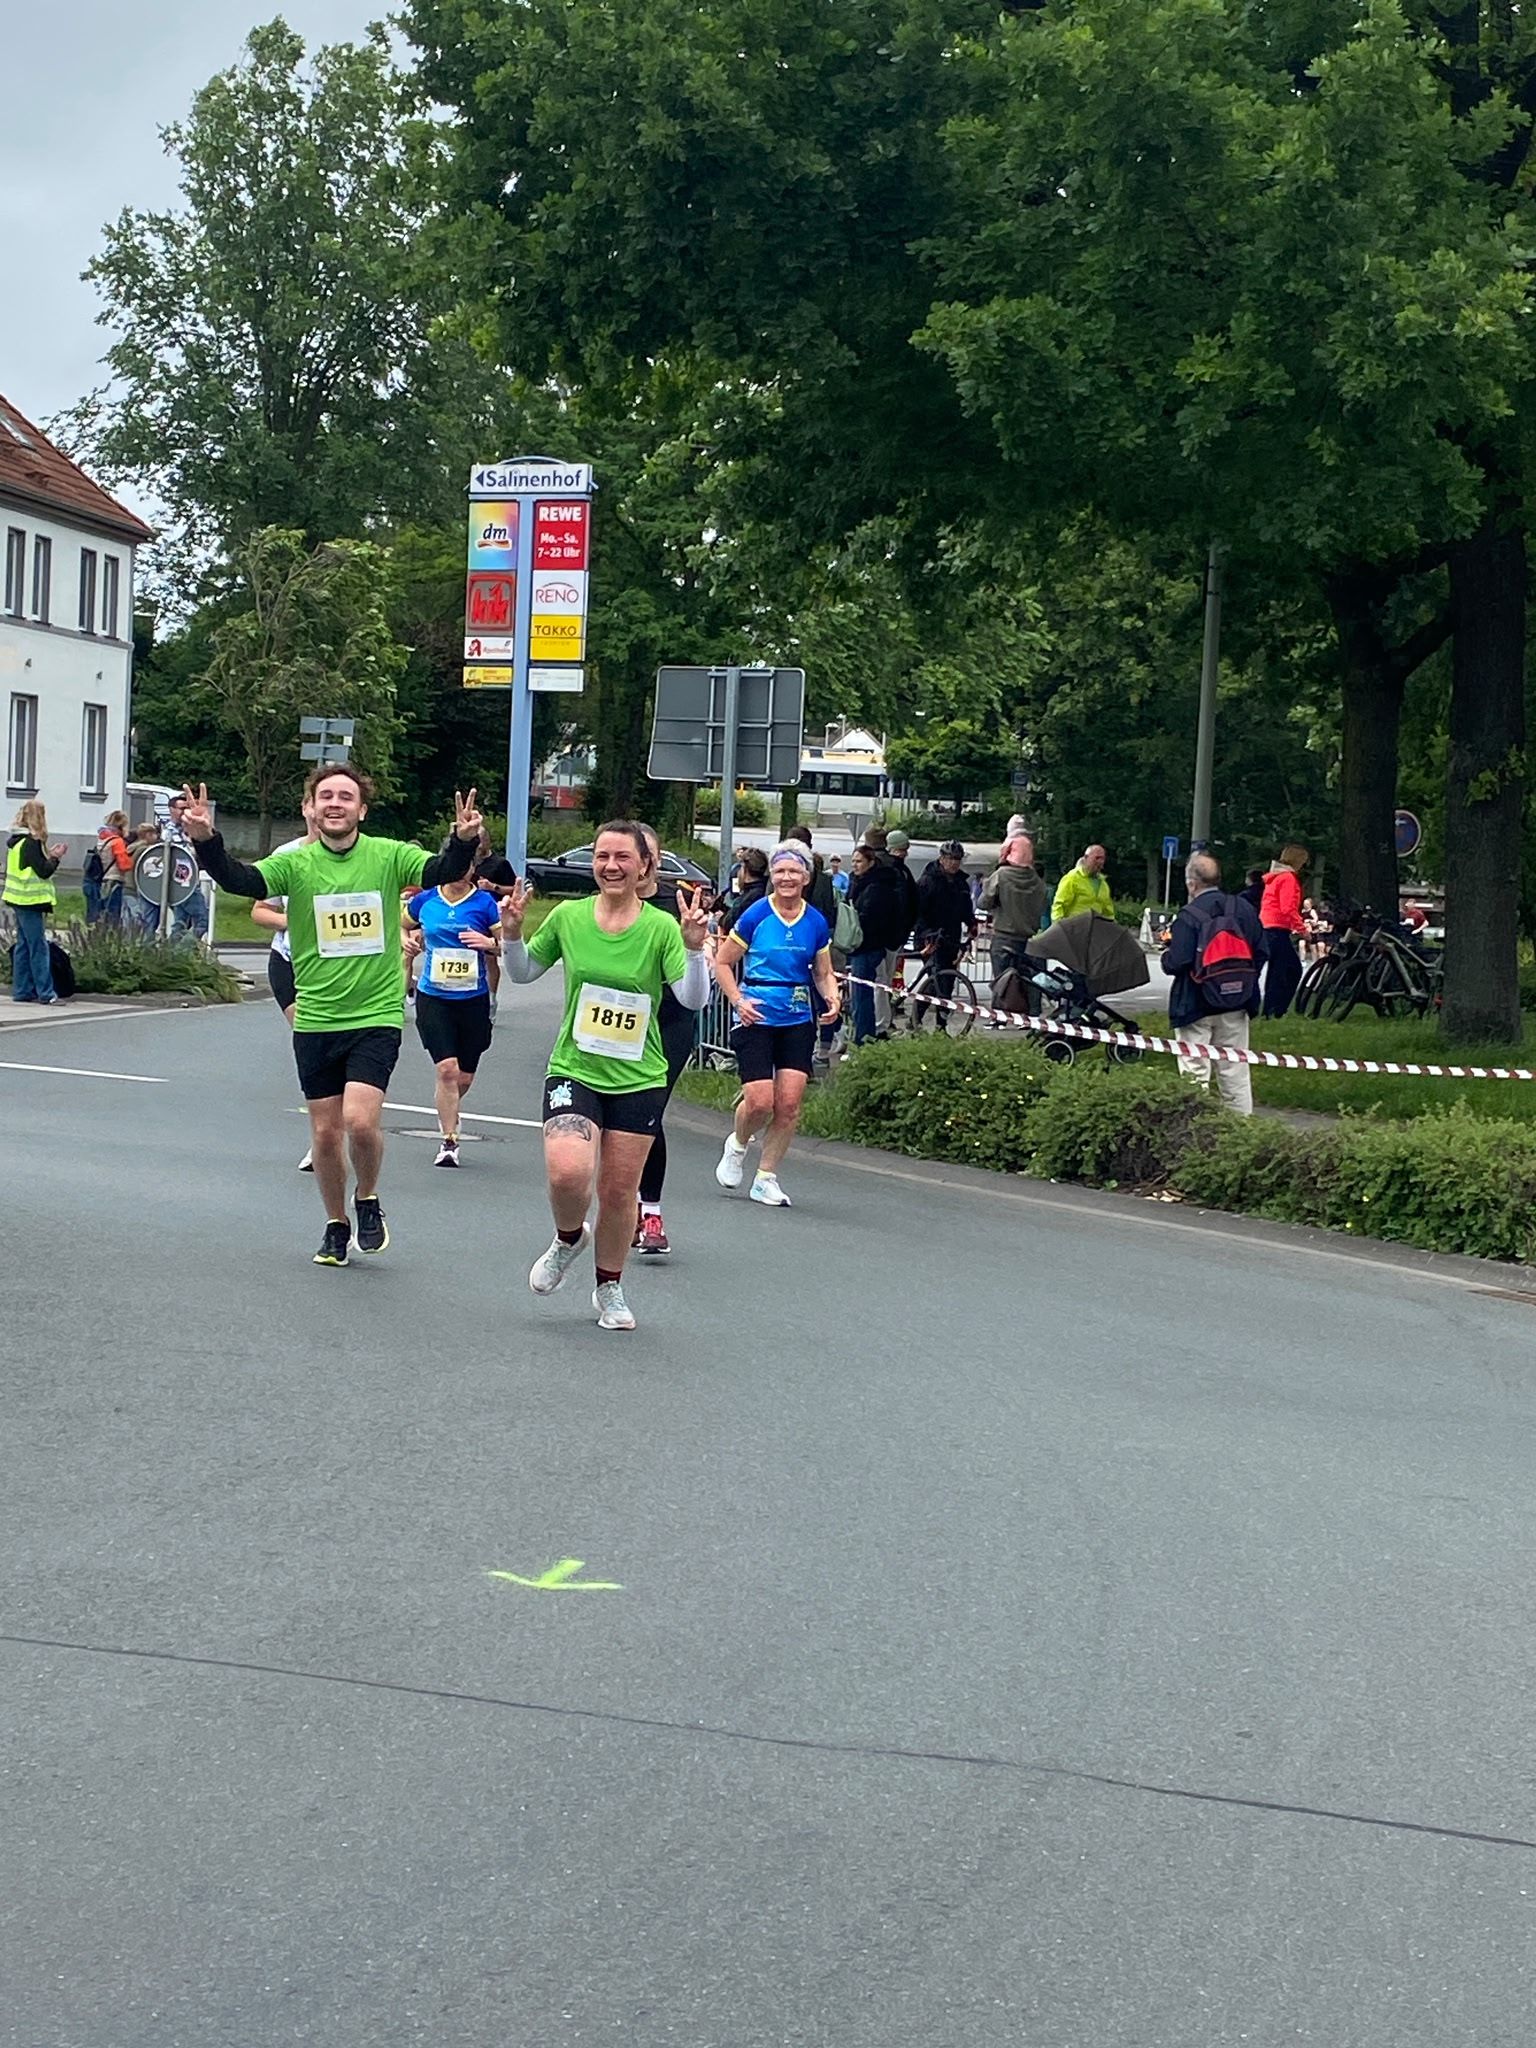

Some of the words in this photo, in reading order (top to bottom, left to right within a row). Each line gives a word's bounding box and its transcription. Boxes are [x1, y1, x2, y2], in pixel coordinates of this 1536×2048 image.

[486, 469, 582, 487] Salinenhof
[538, 506, 582, 522] REWE
[483, 523, 507, 540] dm
[563, 546, 581, 558] Uhr
[535, 589, 579, 603] RENO
[328, 911, 372, 930] 1103
[440, 961, 470, 974] 1739
[591, 1006, 637, 1031] 1815
